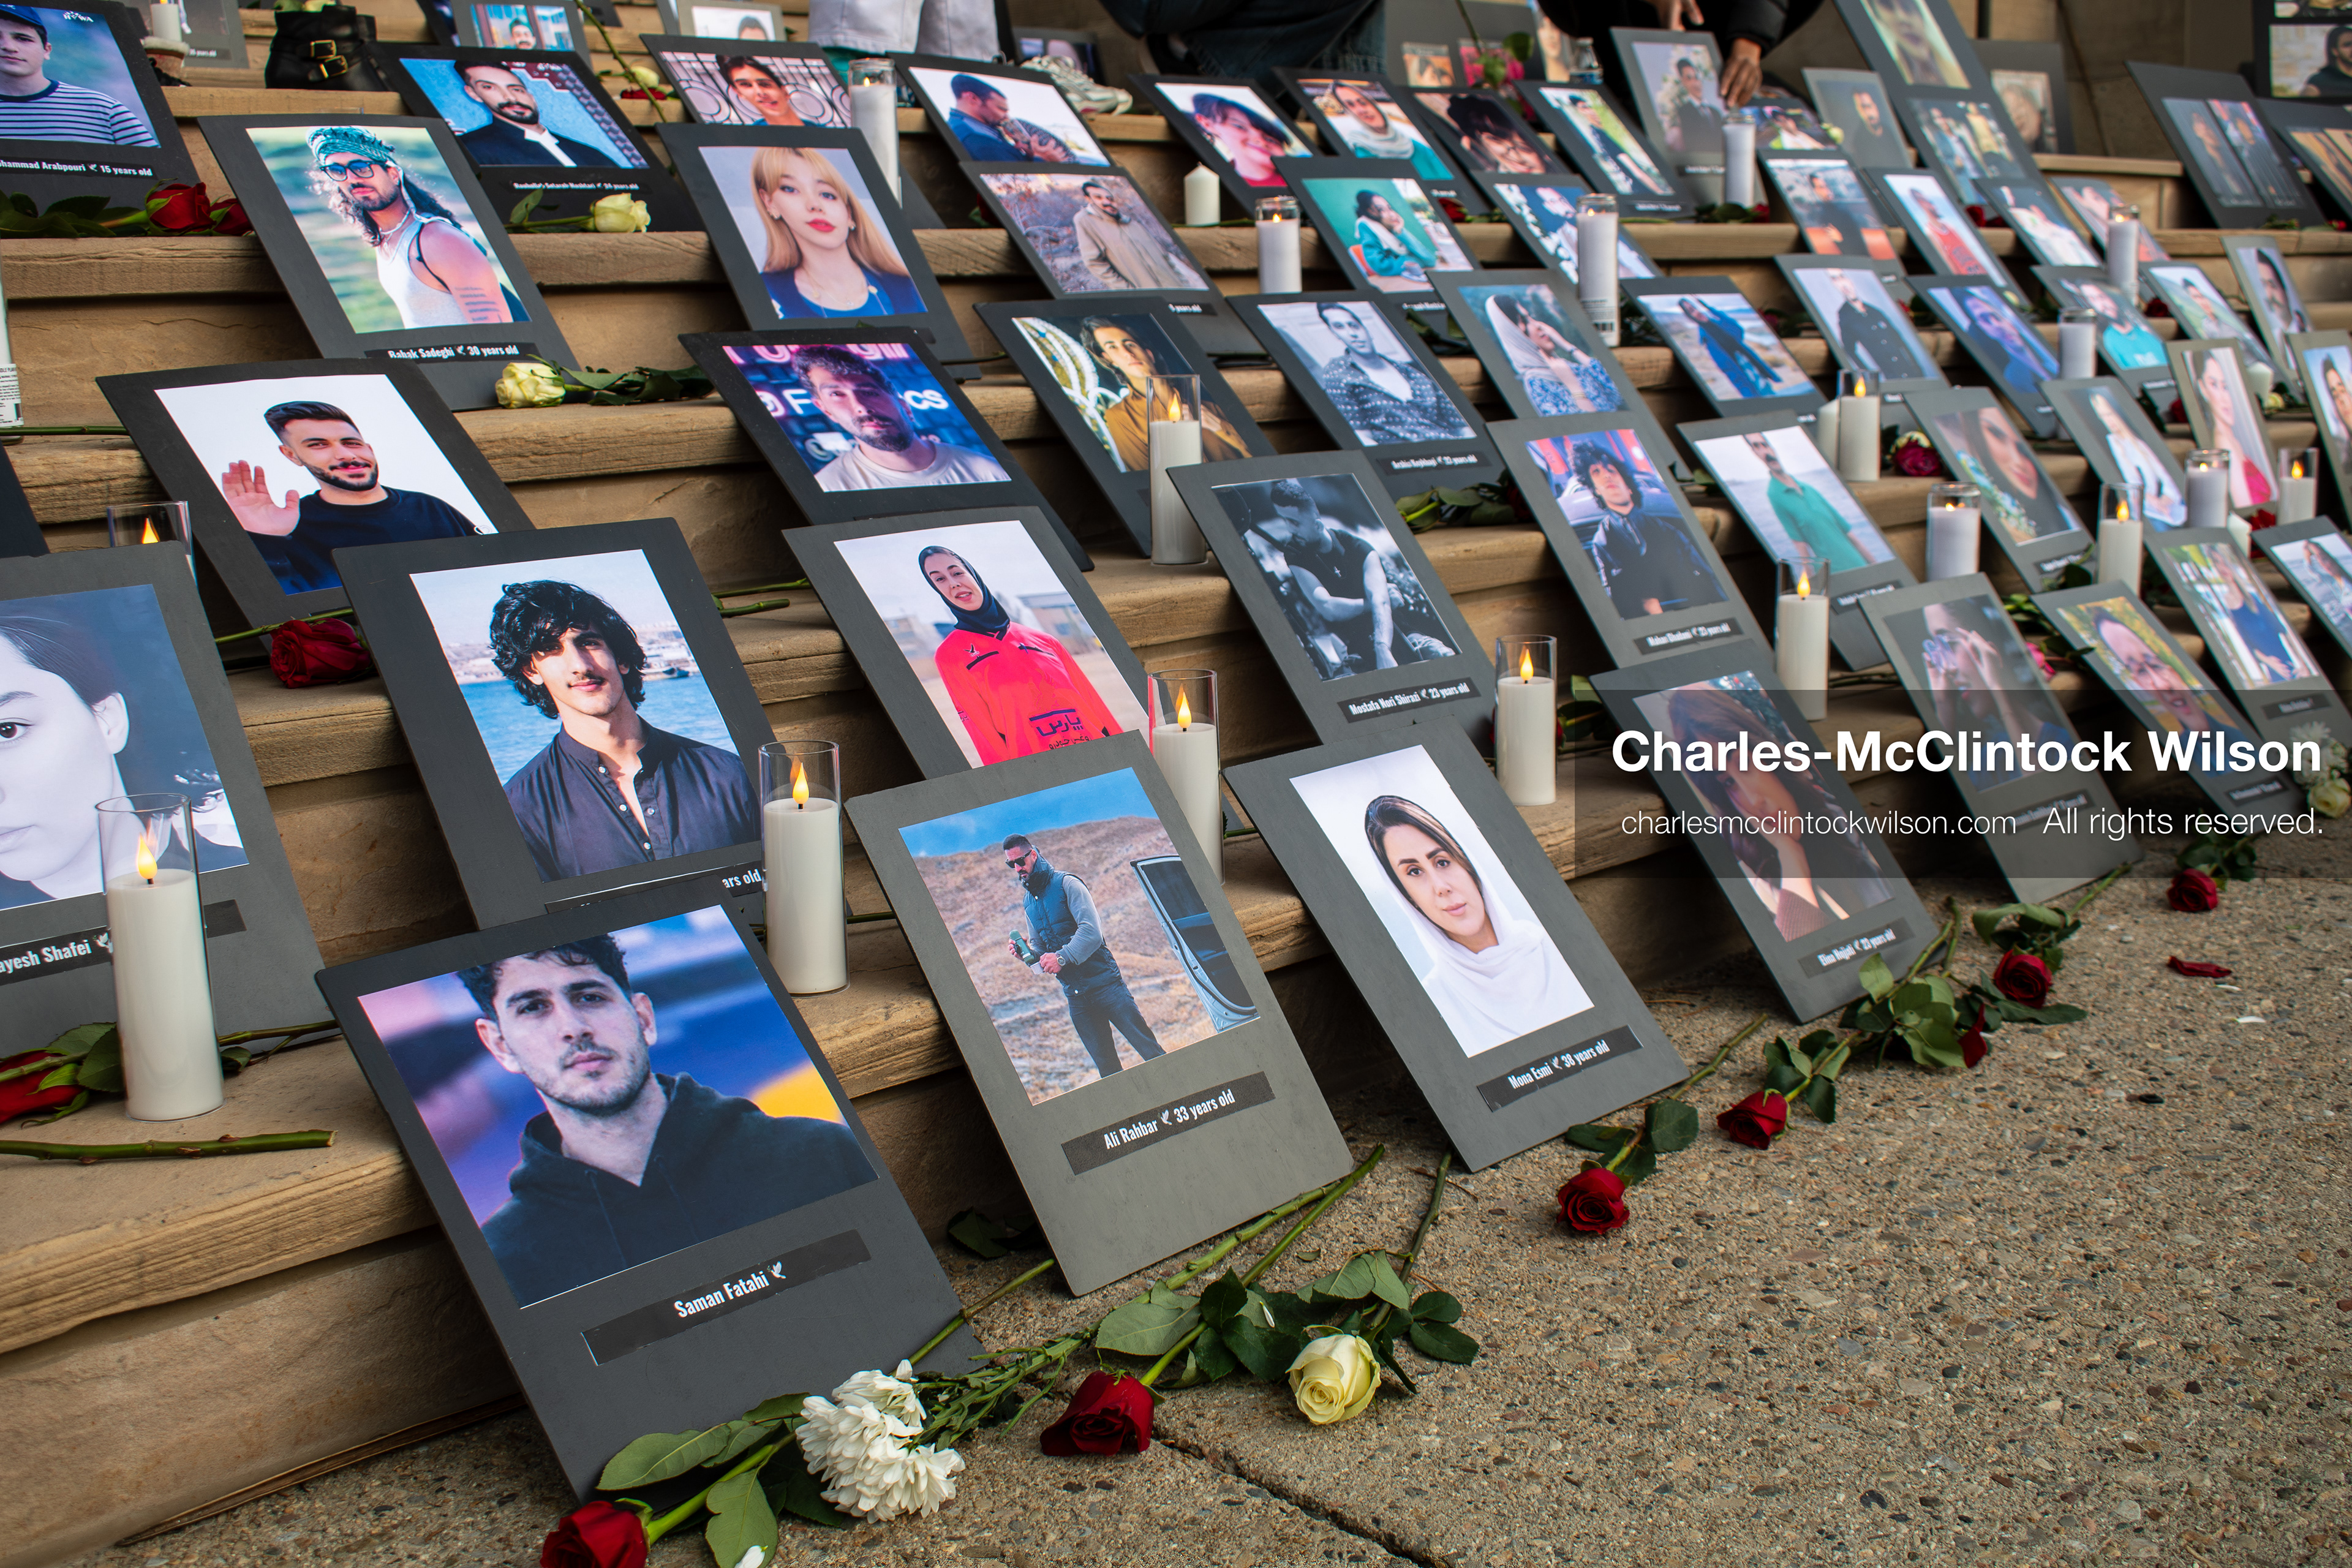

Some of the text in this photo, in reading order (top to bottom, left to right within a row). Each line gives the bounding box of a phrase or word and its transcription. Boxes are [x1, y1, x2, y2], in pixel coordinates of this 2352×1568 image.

[0, 159, 40, 169] hammad
[41, 161, 86, 172] Arabpouri
[100, 165, 112, 173] 15
[112, 167, 138, 175] years
[418, 347, 456, 360] Sadeghi
[467, 345, 481, 356] 30
[480, 346, 504, 357] years
[505, 345, 520, 355] old
[1452, 456, 1468, 466] years
[1467, 454, 1478, 464] old
[1706, 625, 1723, 637] years
[1720, 622, 1731, 633] old
[1349, 682, 1471, 715] Mostafa Nori Shirazi 23 years old
[1036, 714, 1084, 737] پارس
[722, 869, 762, 889] ars old
[1869, 934, 1888, 949] years
[1883, 927, 1896, 941] old
[0, 939, 92, 974] ayesh Shafei
[1507, 1039, 1610, 1090] Mona Esmi 38 years old
[1104, 1088, 1235, 1150] Ali Rahbar 33 years old
[674, 1270, 770, 1318] Saman Fatahi
